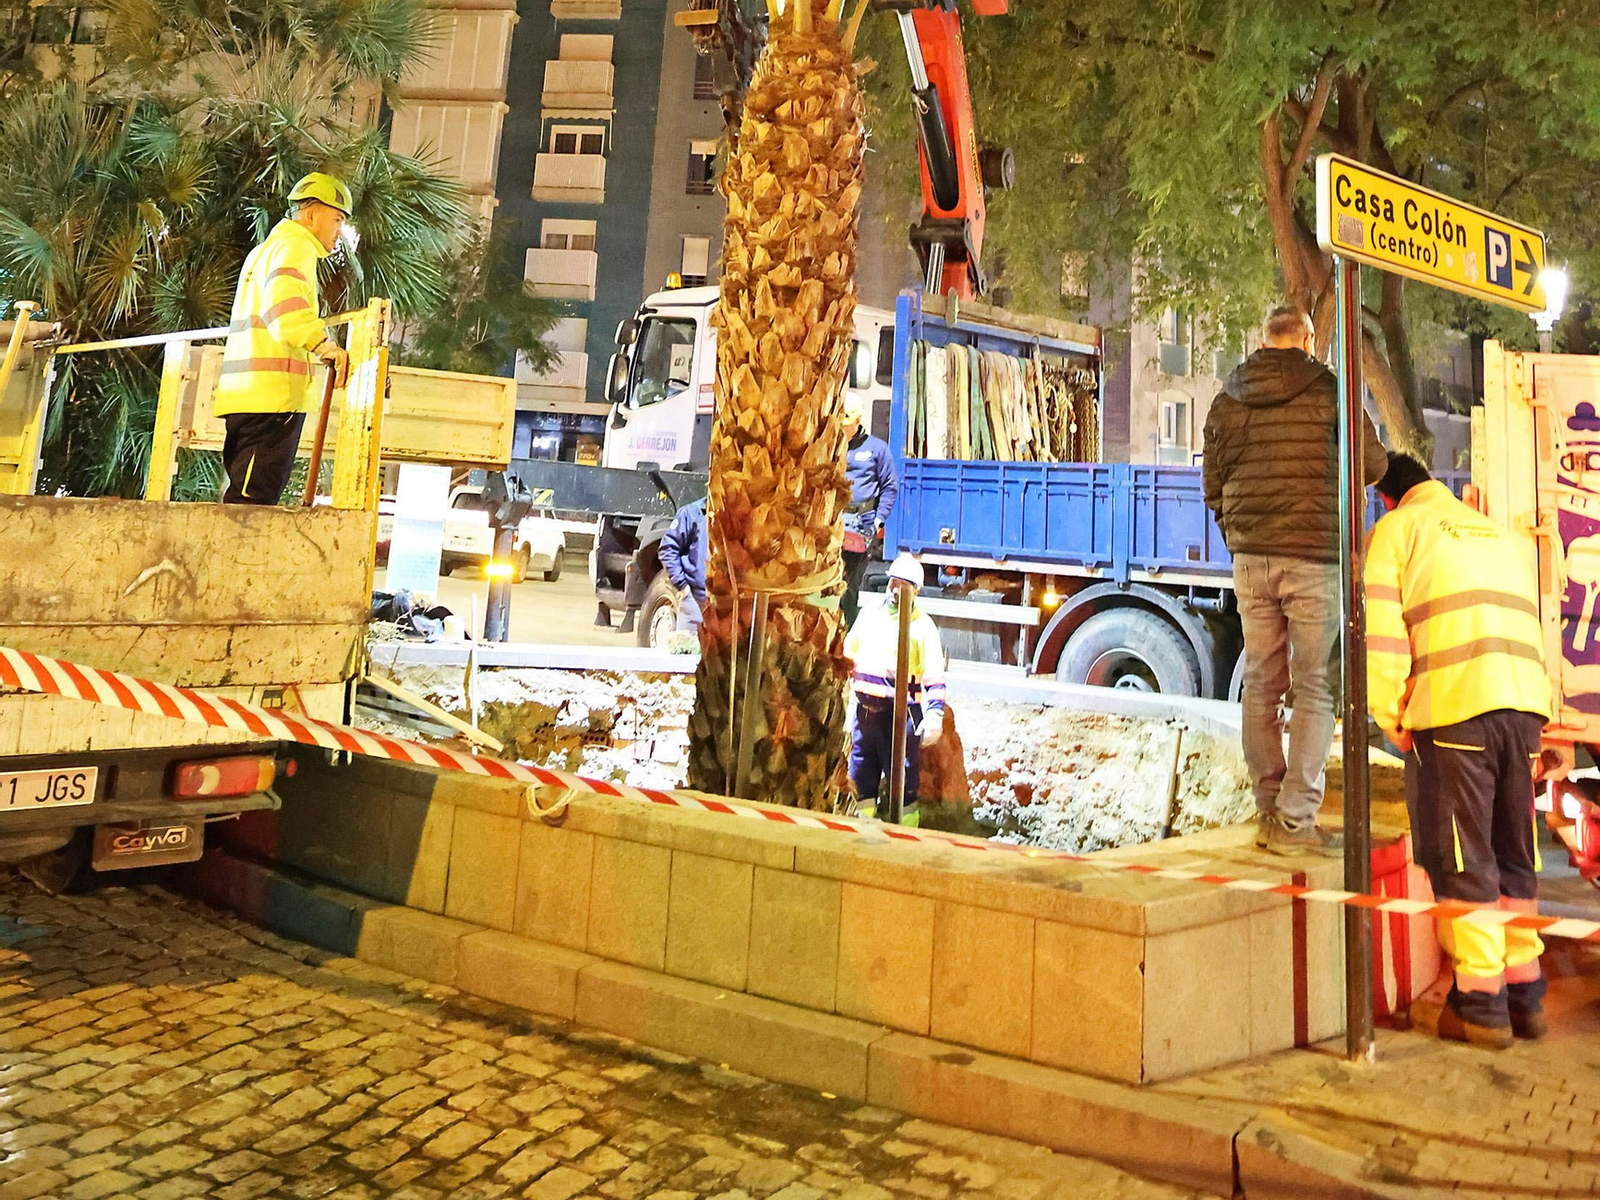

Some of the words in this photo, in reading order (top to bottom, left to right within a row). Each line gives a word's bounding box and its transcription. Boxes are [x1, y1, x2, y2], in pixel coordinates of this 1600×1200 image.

[1335, 174, 1395, 224] Casa
[1404, 198, 1467, 248] Colón
[1370, 221, 1438, 268] (centro)
[1488, 230, 1508, 282] P
[637, 436, 677, 452] CERREJON
[0, 776, 18, 805] 1
[35, 773, 87, 803] JGS
